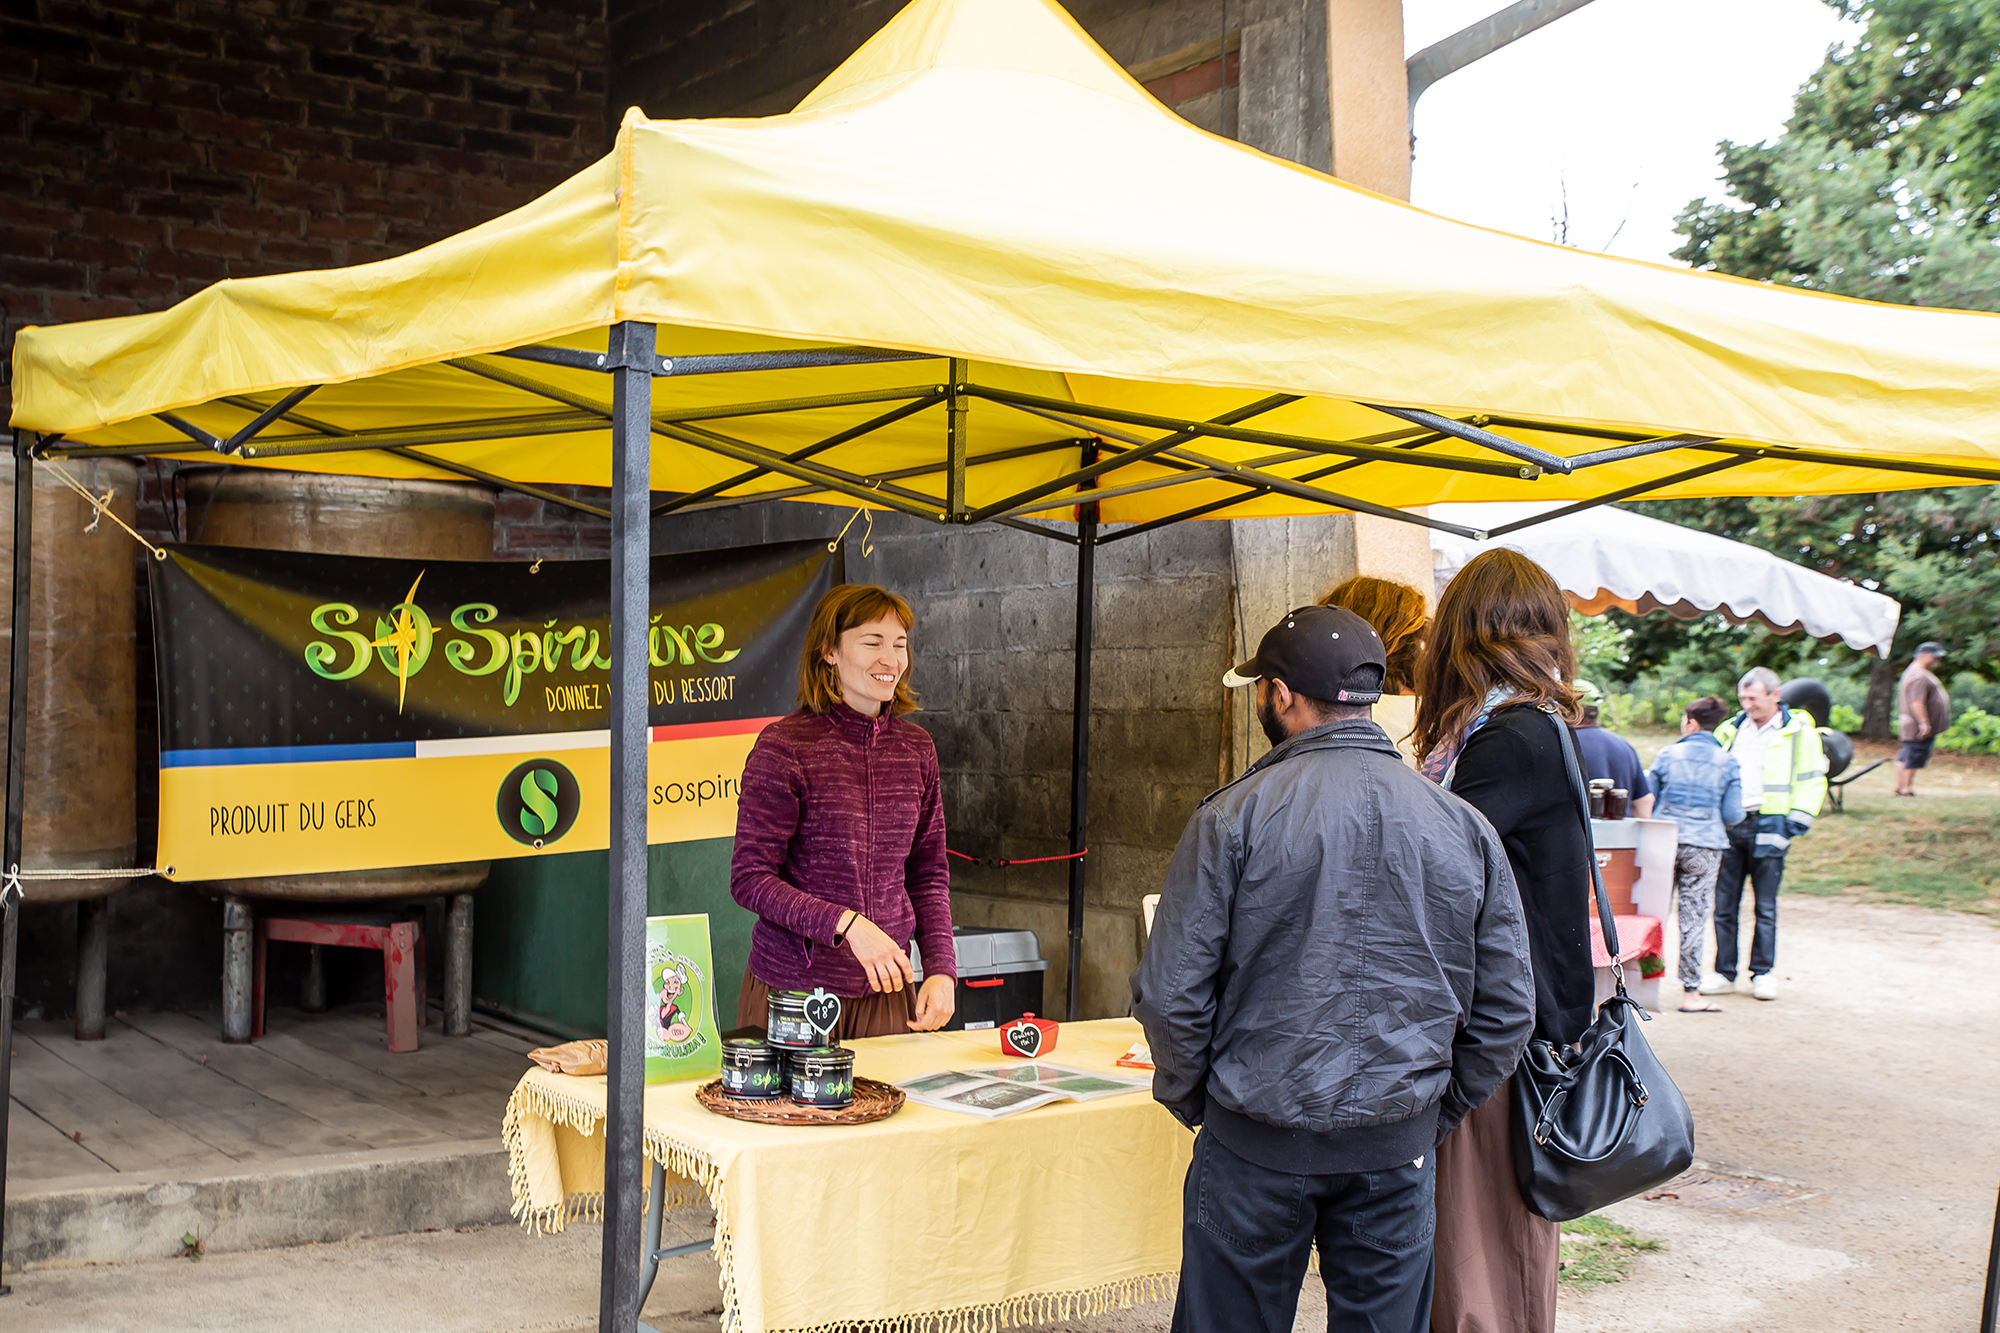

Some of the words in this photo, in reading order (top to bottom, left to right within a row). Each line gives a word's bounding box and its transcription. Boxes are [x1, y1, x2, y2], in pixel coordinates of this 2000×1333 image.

[445, 602, 742, 707] Spiruine
[545, 684, 603, 712] DONNEZ
[653, 680, 675, 705] DU
[681, 675, 736, 704] RESSORT
[210, 803, 290, 836] PRODUIT
[300, 801, 324, 831] DU
[335, 798, 376, 829] GERS
